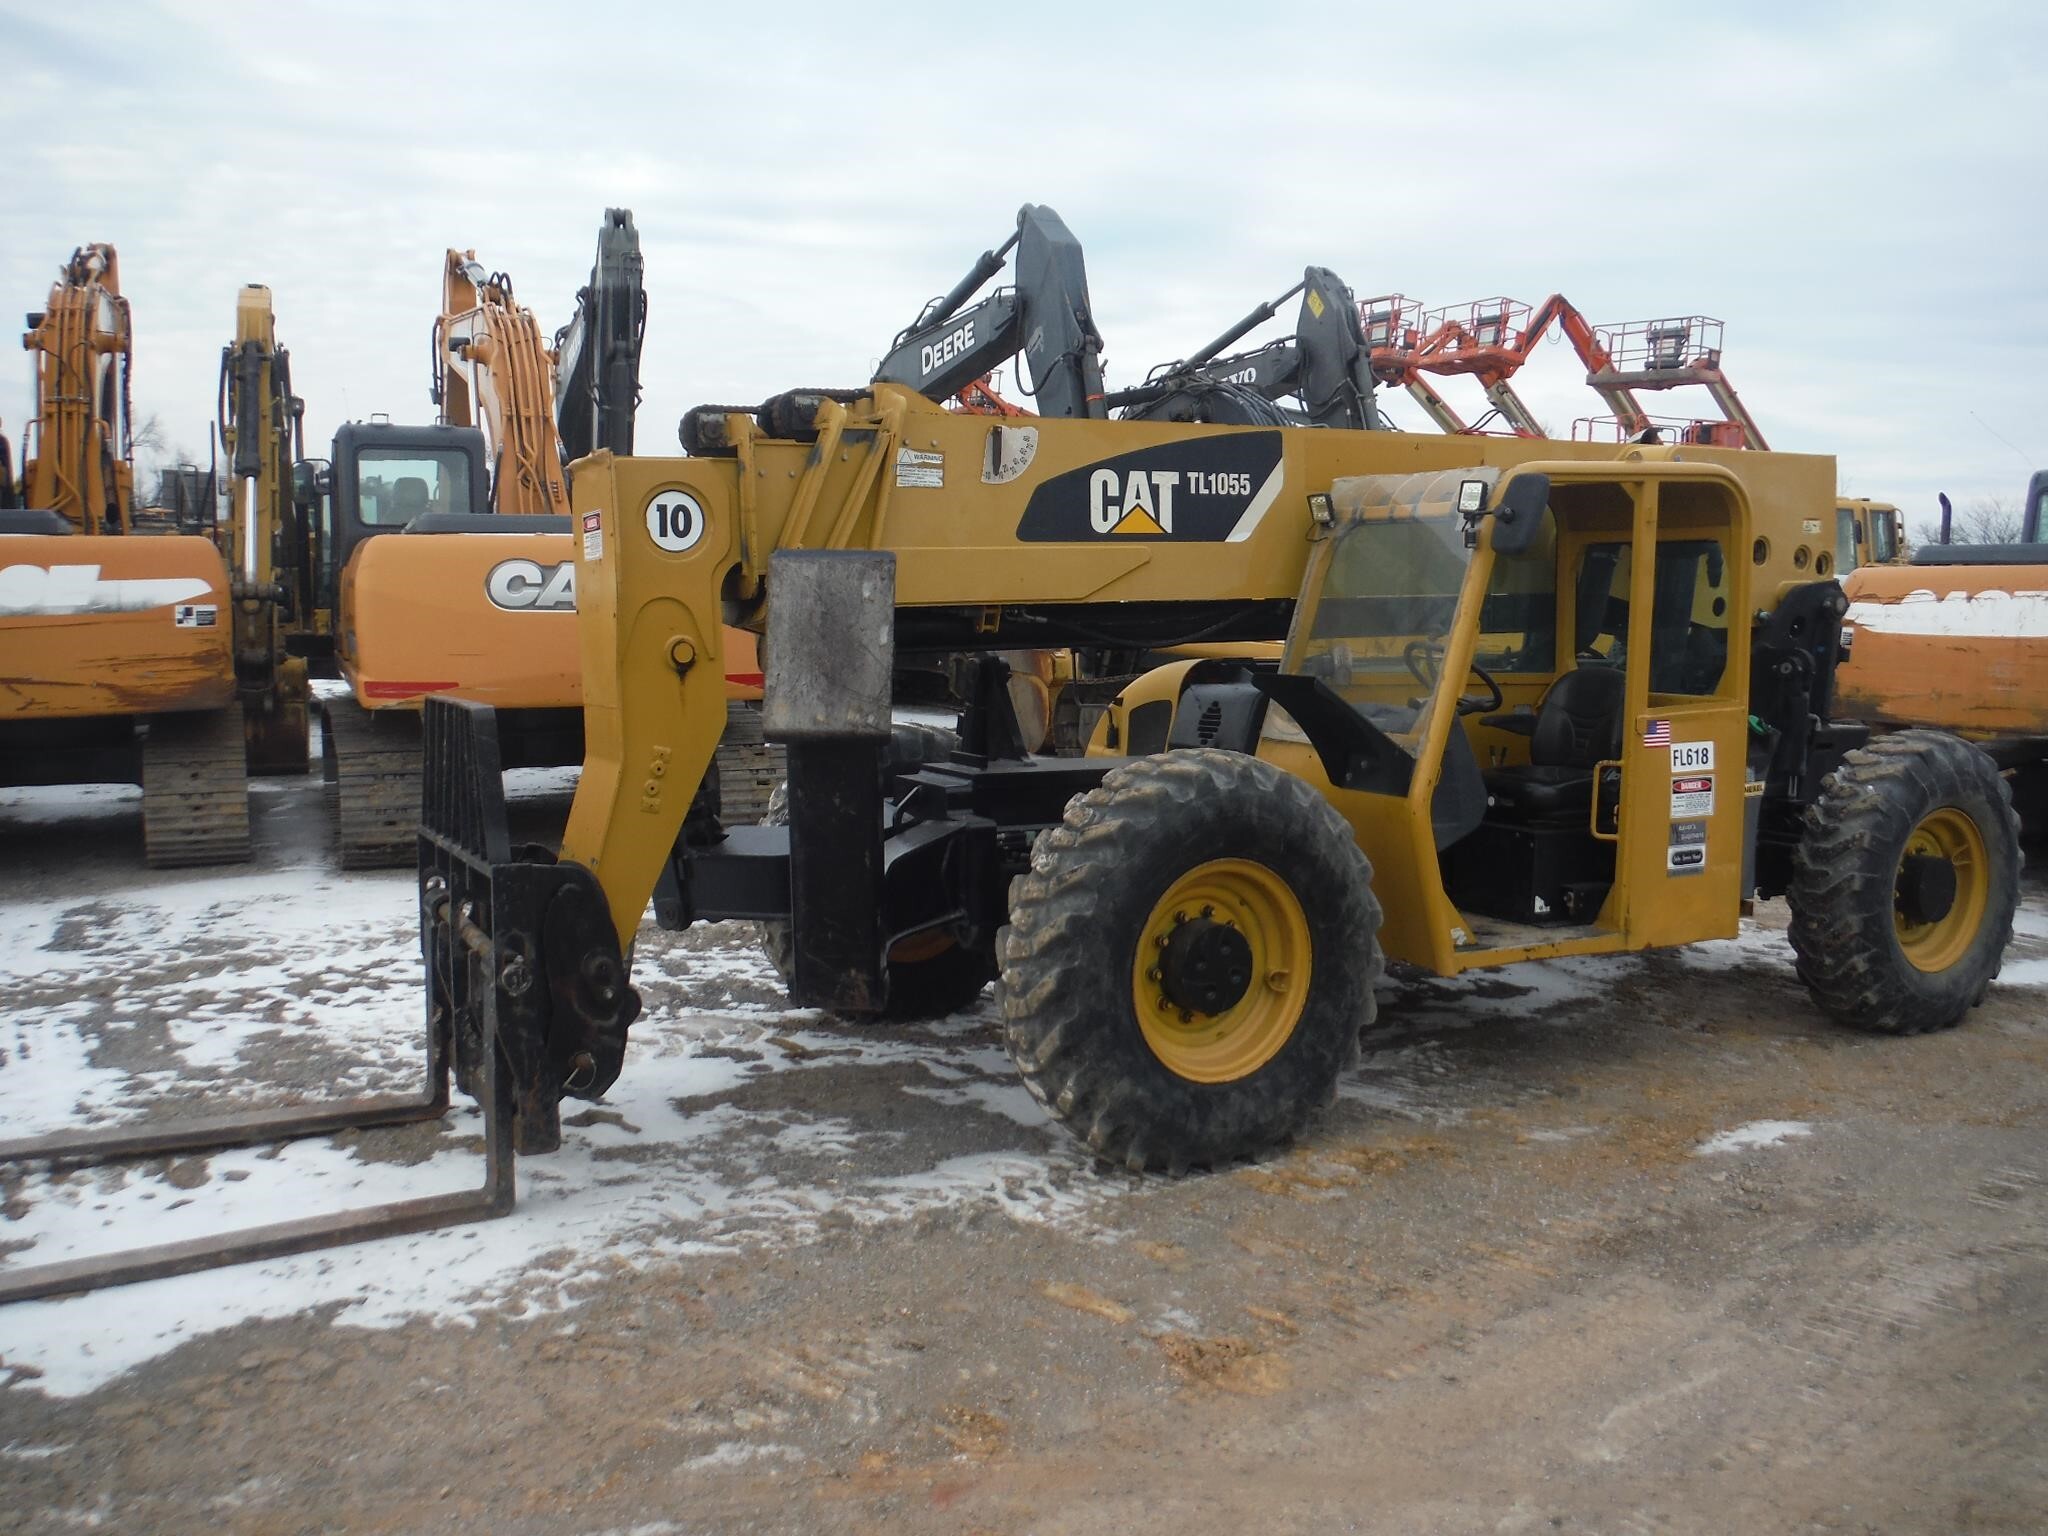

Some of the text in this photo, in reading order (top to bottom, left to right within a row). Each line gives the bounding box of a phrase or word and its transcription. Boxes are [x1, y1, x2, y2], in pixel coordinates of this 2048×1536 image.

[921, 320, 976, 376] DEERE
[1221, 367, 1257, 384] VO
[1089, 468, 1251, 534] CAT TL1055
[656, 503, 693, 539] 10
[1673, 747, 1709, 767] FL618
